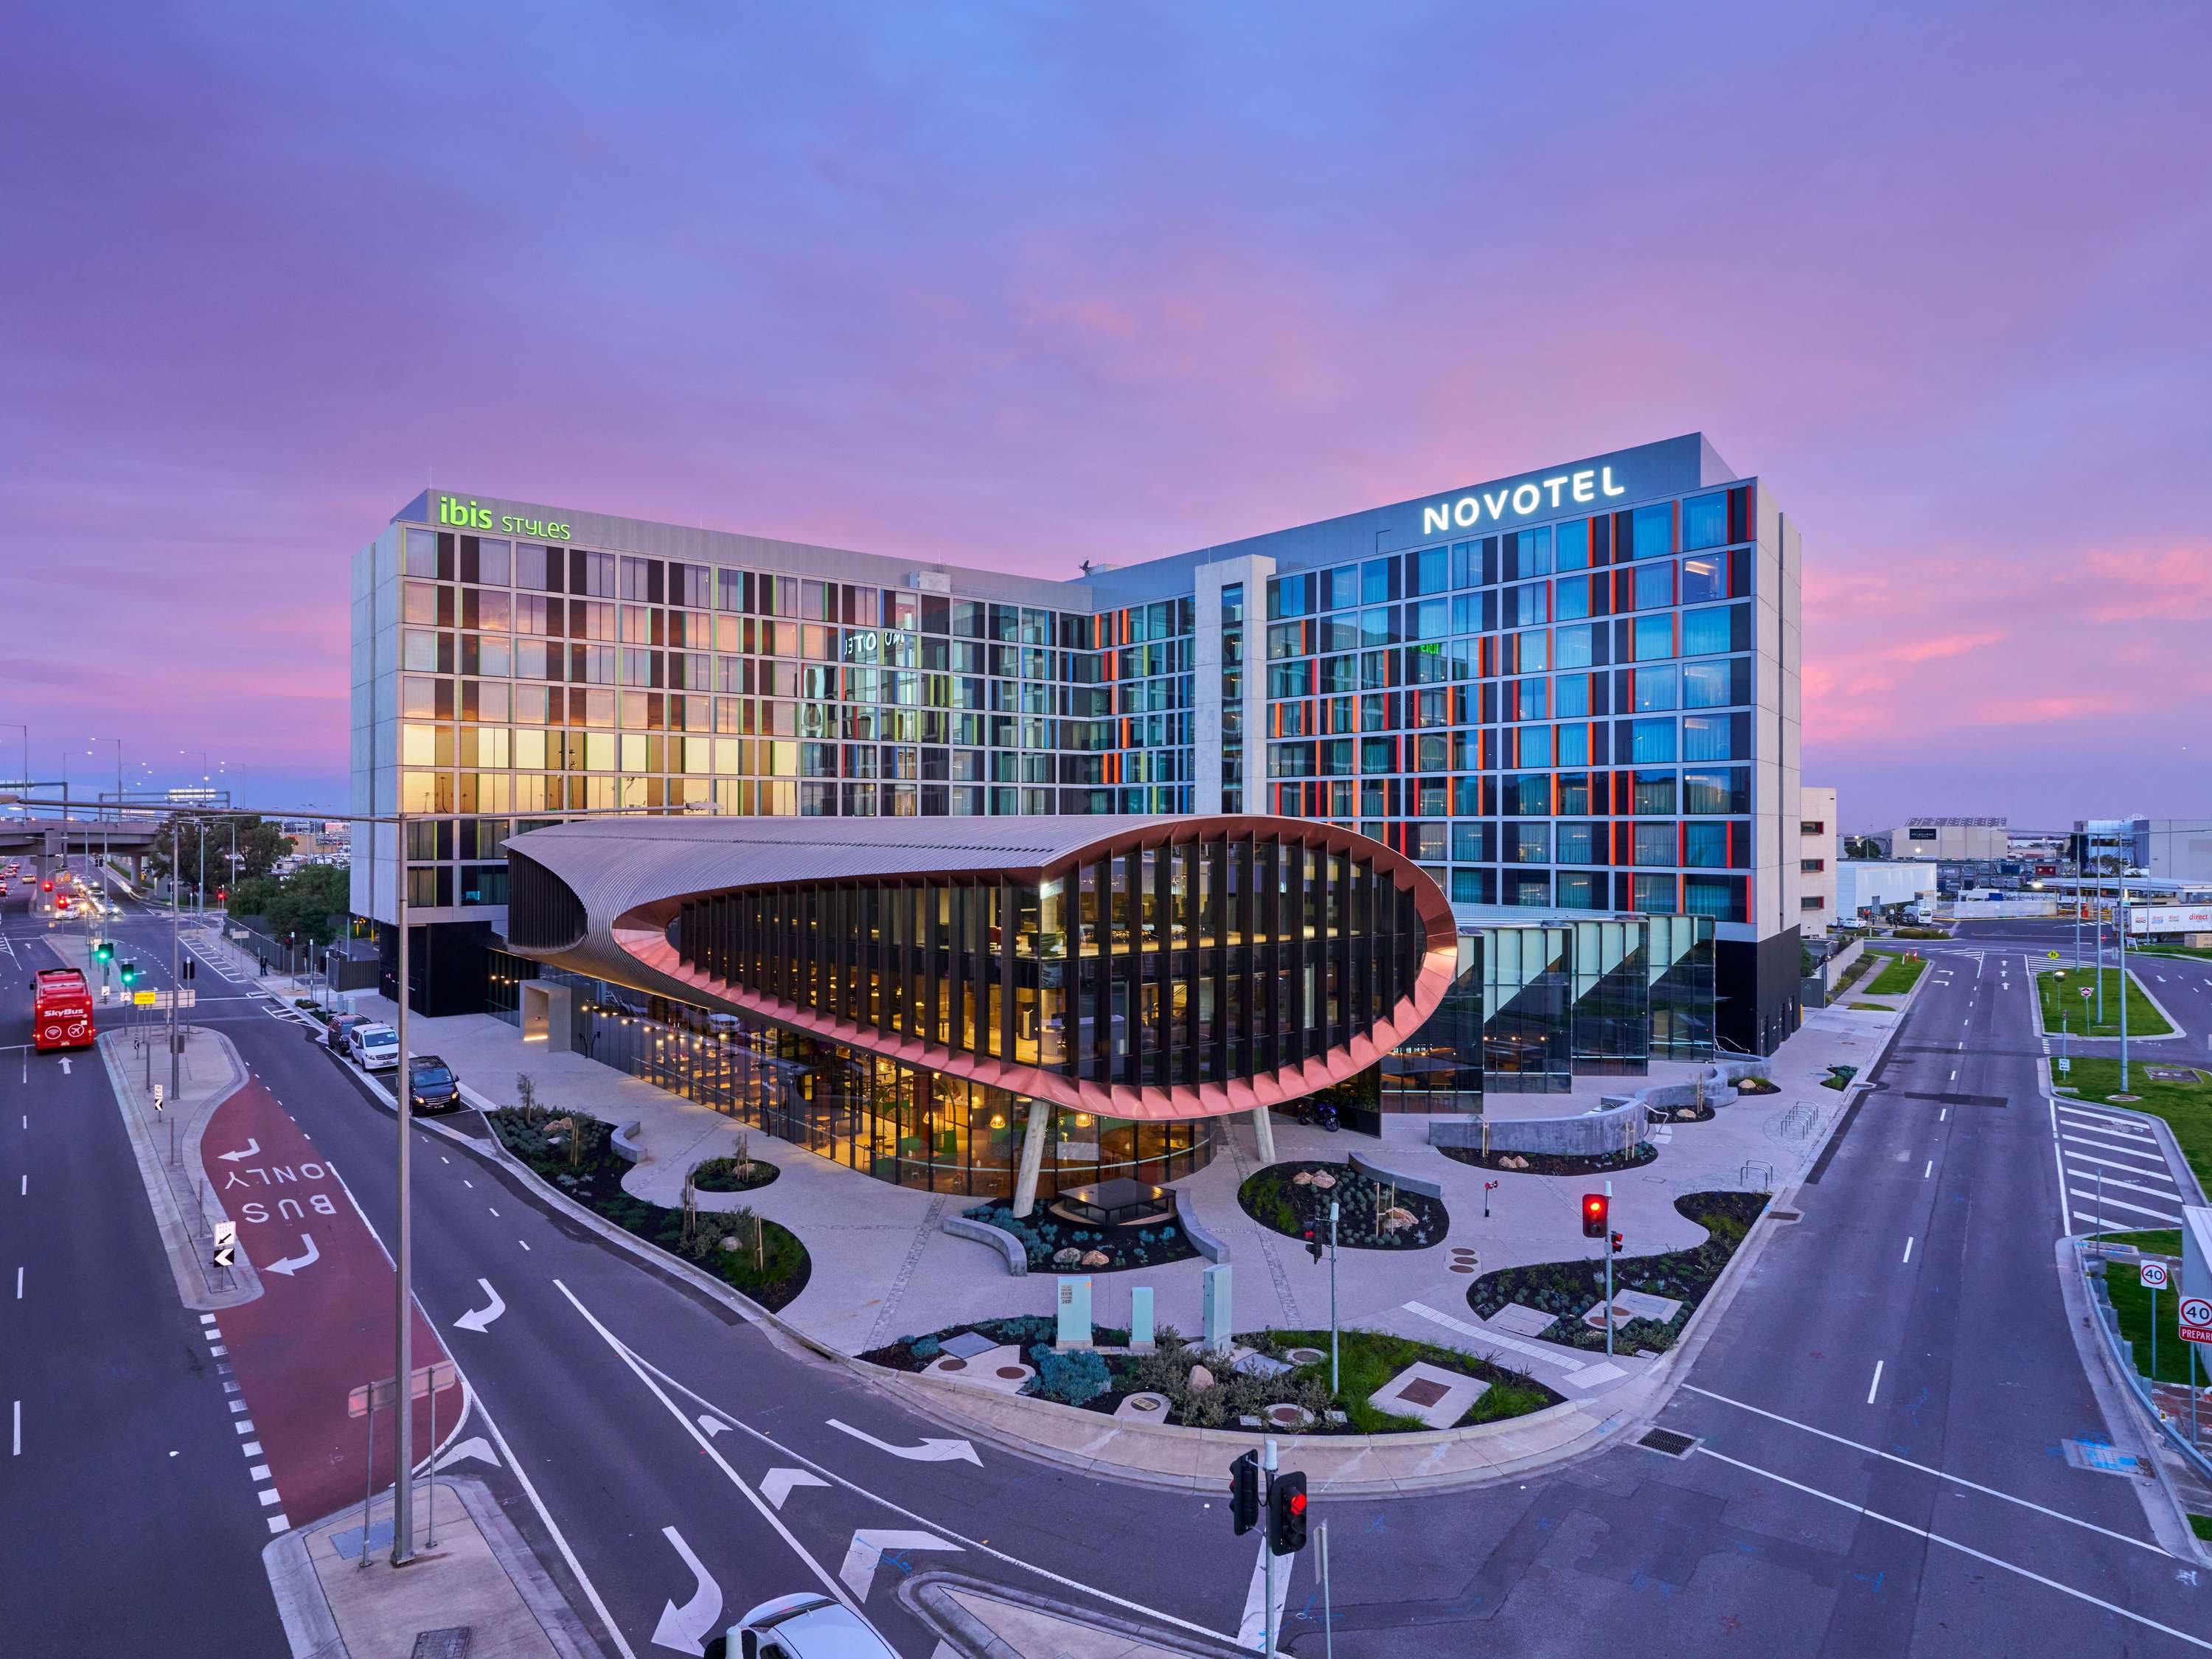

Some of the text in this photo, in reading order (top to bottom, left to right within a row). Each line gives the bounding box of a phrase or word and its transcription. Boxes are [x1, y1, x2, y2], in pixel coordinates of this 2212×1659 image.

[440, 496, 493, 529] ibis
[1424, 467, 1624, 535] NOVOTEL
[44, 1009, 84, 1017] SkyBus
[225, 1163, 324, 1189] ONLY
[242, 1194, 336, 1223] BUS
[2145, 1269, 2163, 1280] 40
[2186, 1306, 2210, 1320] 40
